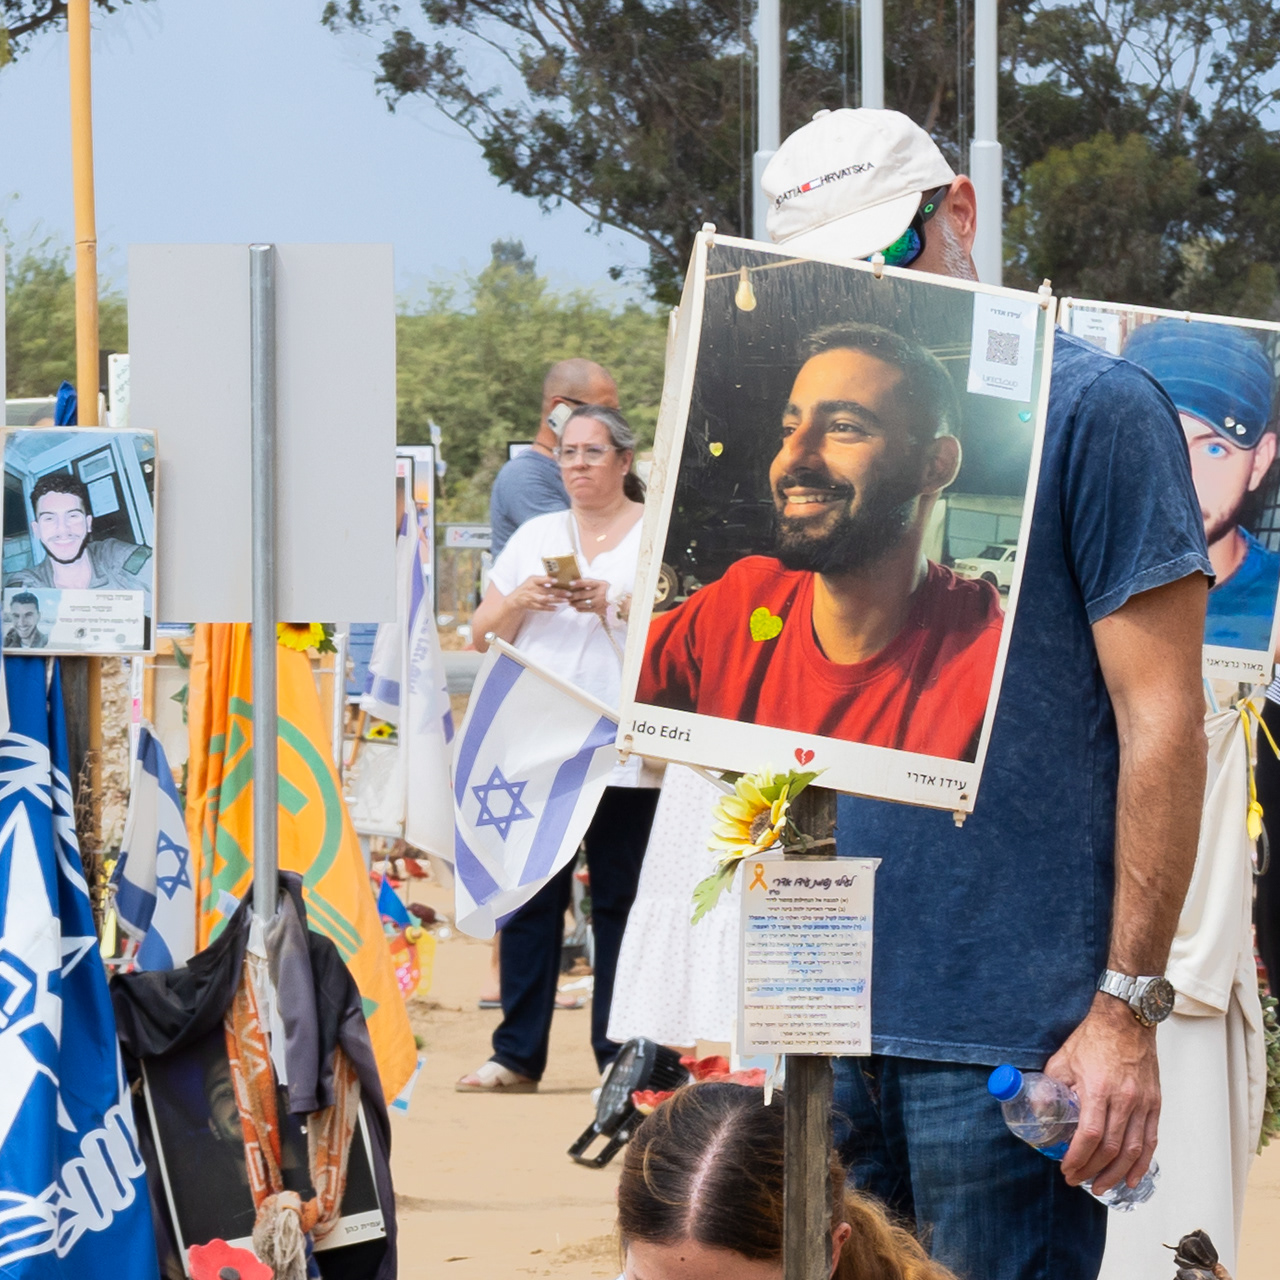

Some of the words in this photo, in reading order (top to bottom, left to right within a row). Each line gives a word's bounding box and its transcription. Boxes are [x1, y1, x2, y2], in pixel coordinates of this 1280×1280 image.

[820, 162, 875, 186] HRVATSKA
[1242, 662, 1264, 672] מאור
[631, 718, 657, 736] Ido
[659, 725, 692, 743] Edri
[906, 770, 936, 787] אדרי
[938, 776, 968, 791] עידו
